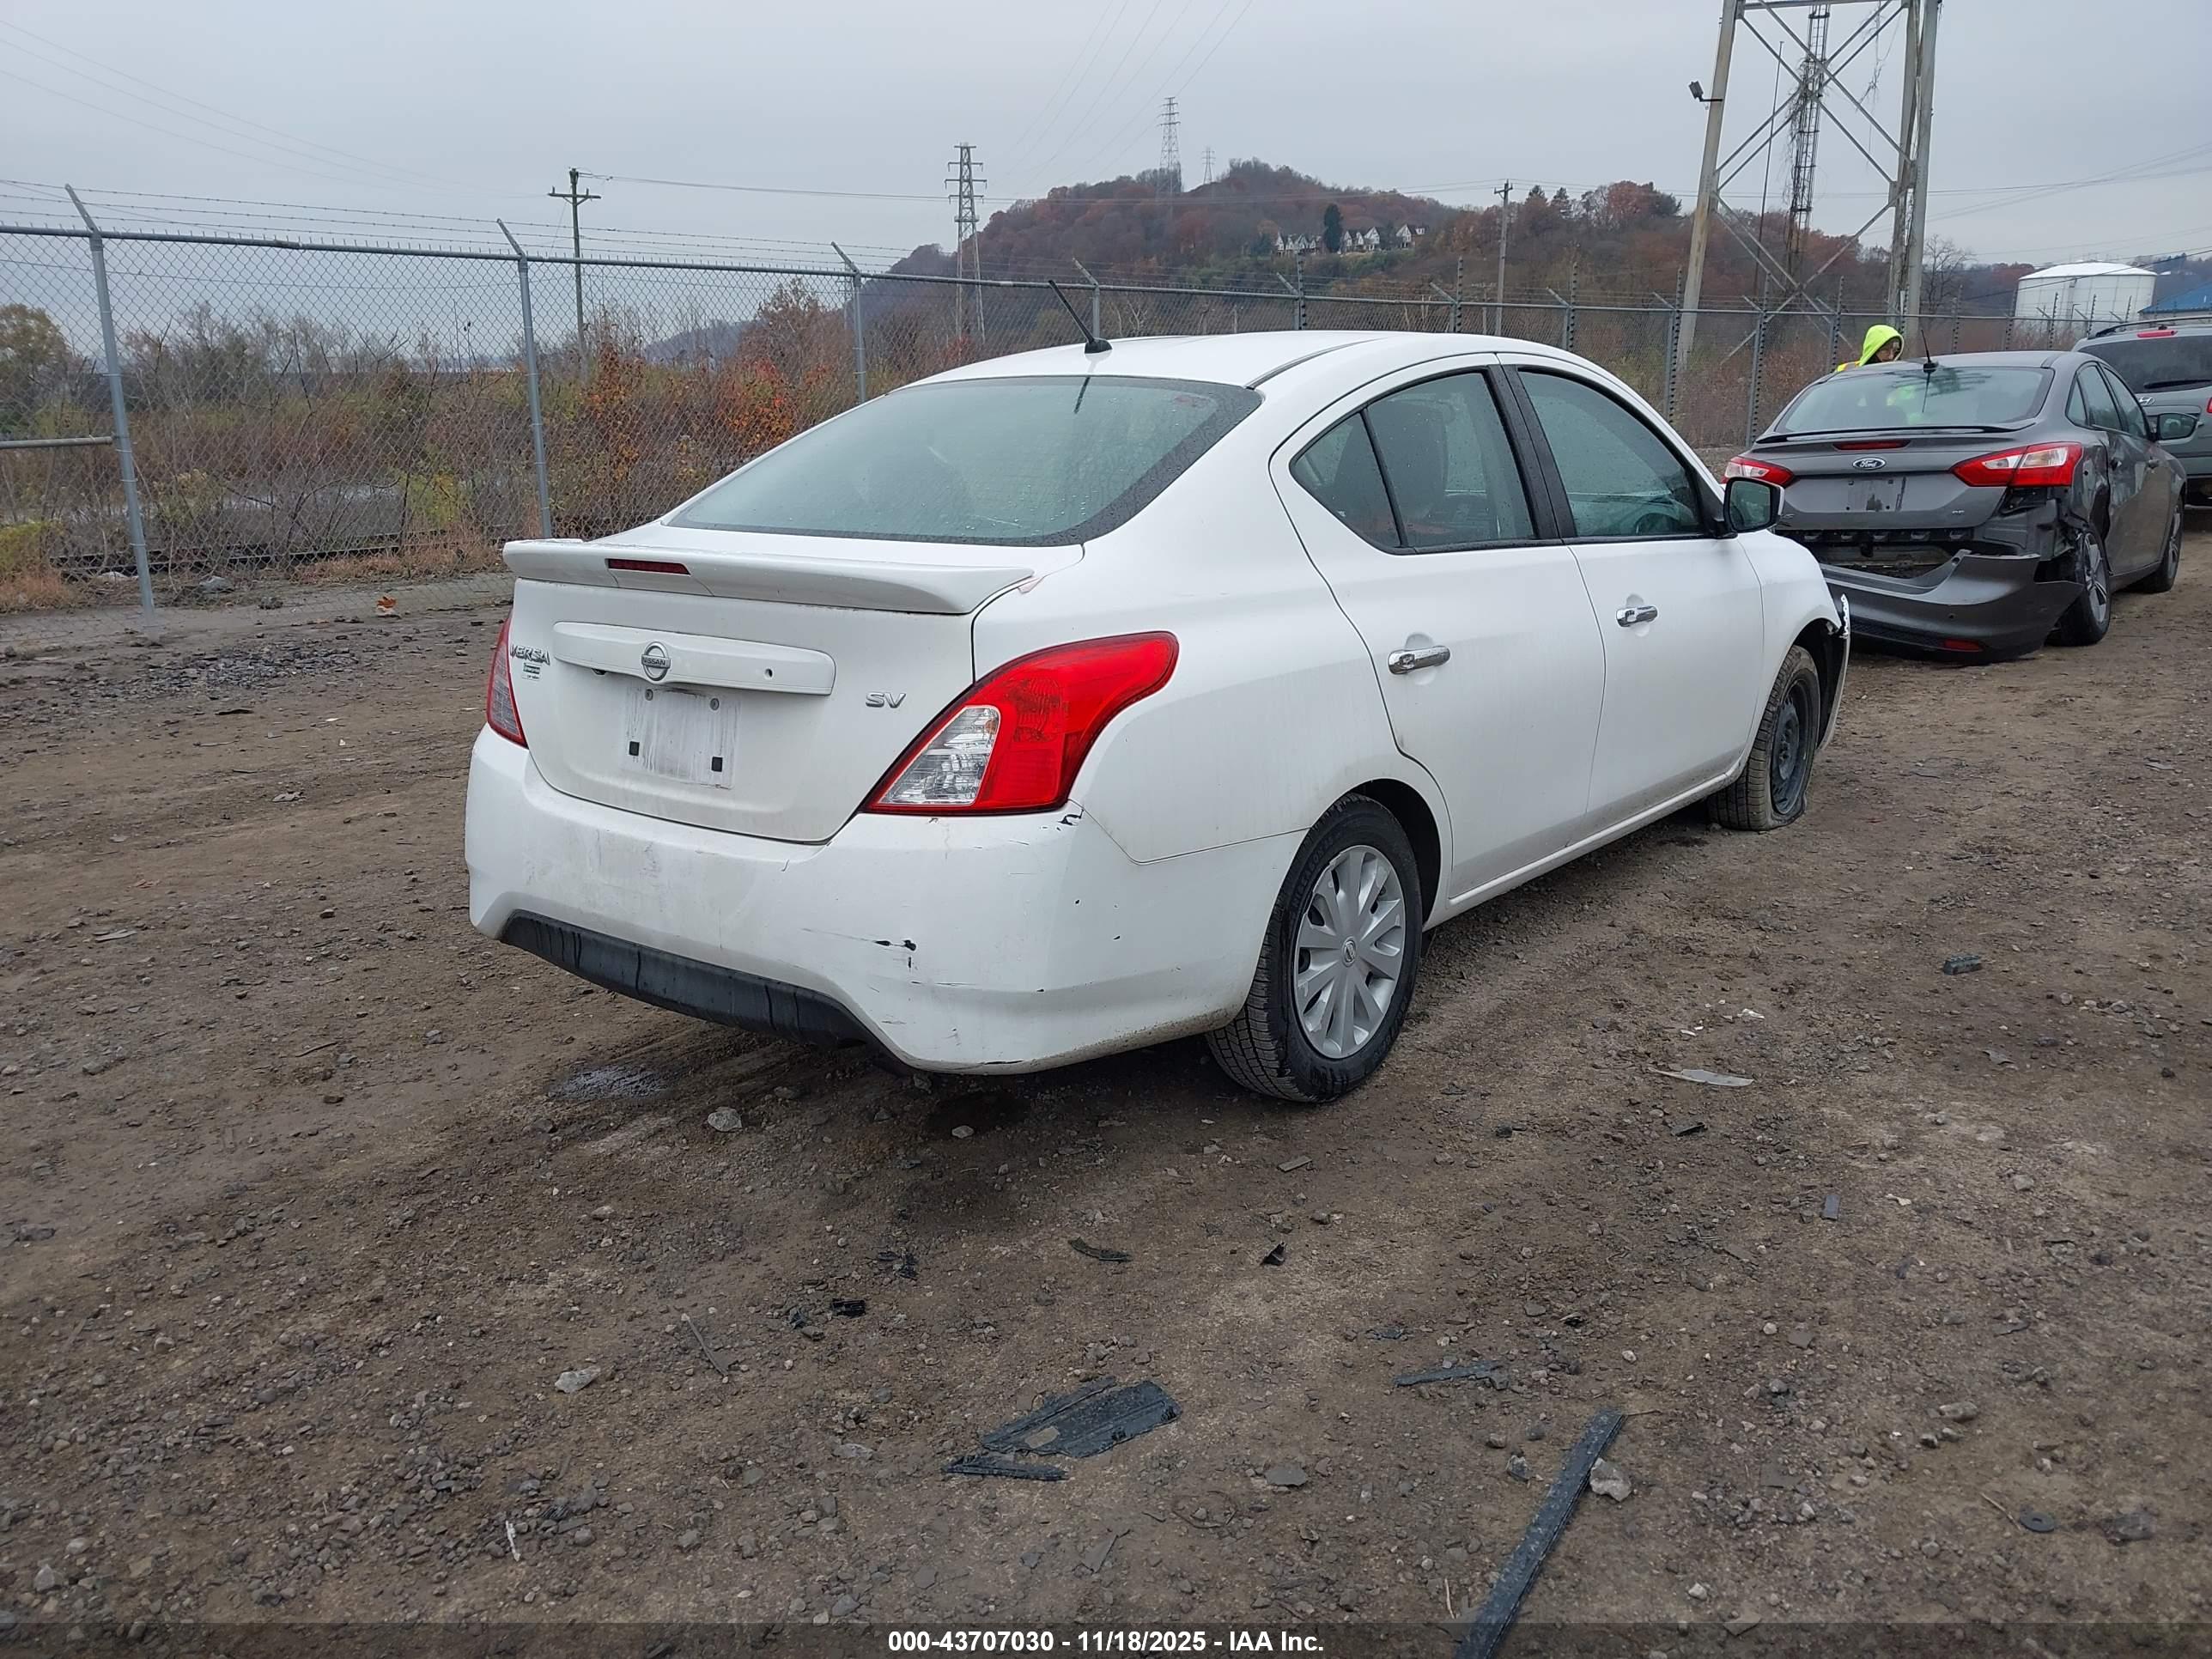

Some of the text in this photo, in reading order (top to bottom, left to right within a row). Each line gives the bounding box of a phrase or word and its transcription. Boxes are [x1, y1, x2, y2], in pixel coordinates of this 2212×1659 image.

[509, 644, 550, 666] VERSA
[642, 657, 666, 667] NISSAN
[865, 691, 907, 708] SV
